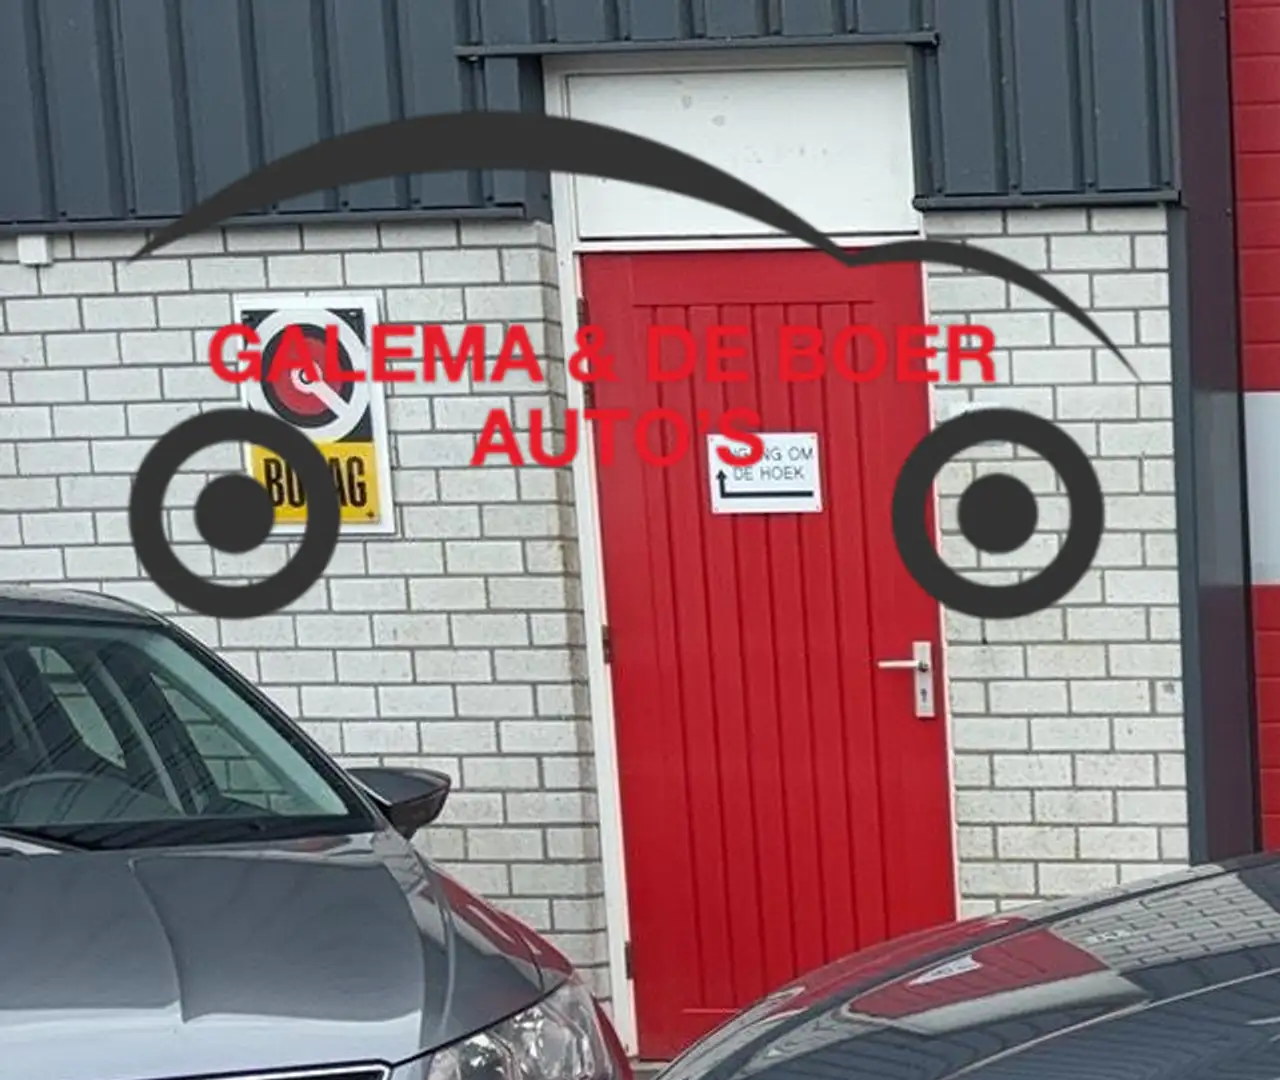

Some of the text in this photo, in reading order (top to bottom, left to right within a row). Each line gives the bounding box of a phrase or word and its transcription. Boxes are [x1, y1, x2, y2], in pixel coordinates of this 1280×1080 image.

[264, 455, 367, 508] BOAG
[733, 465, 804, 481] DE HOEK
